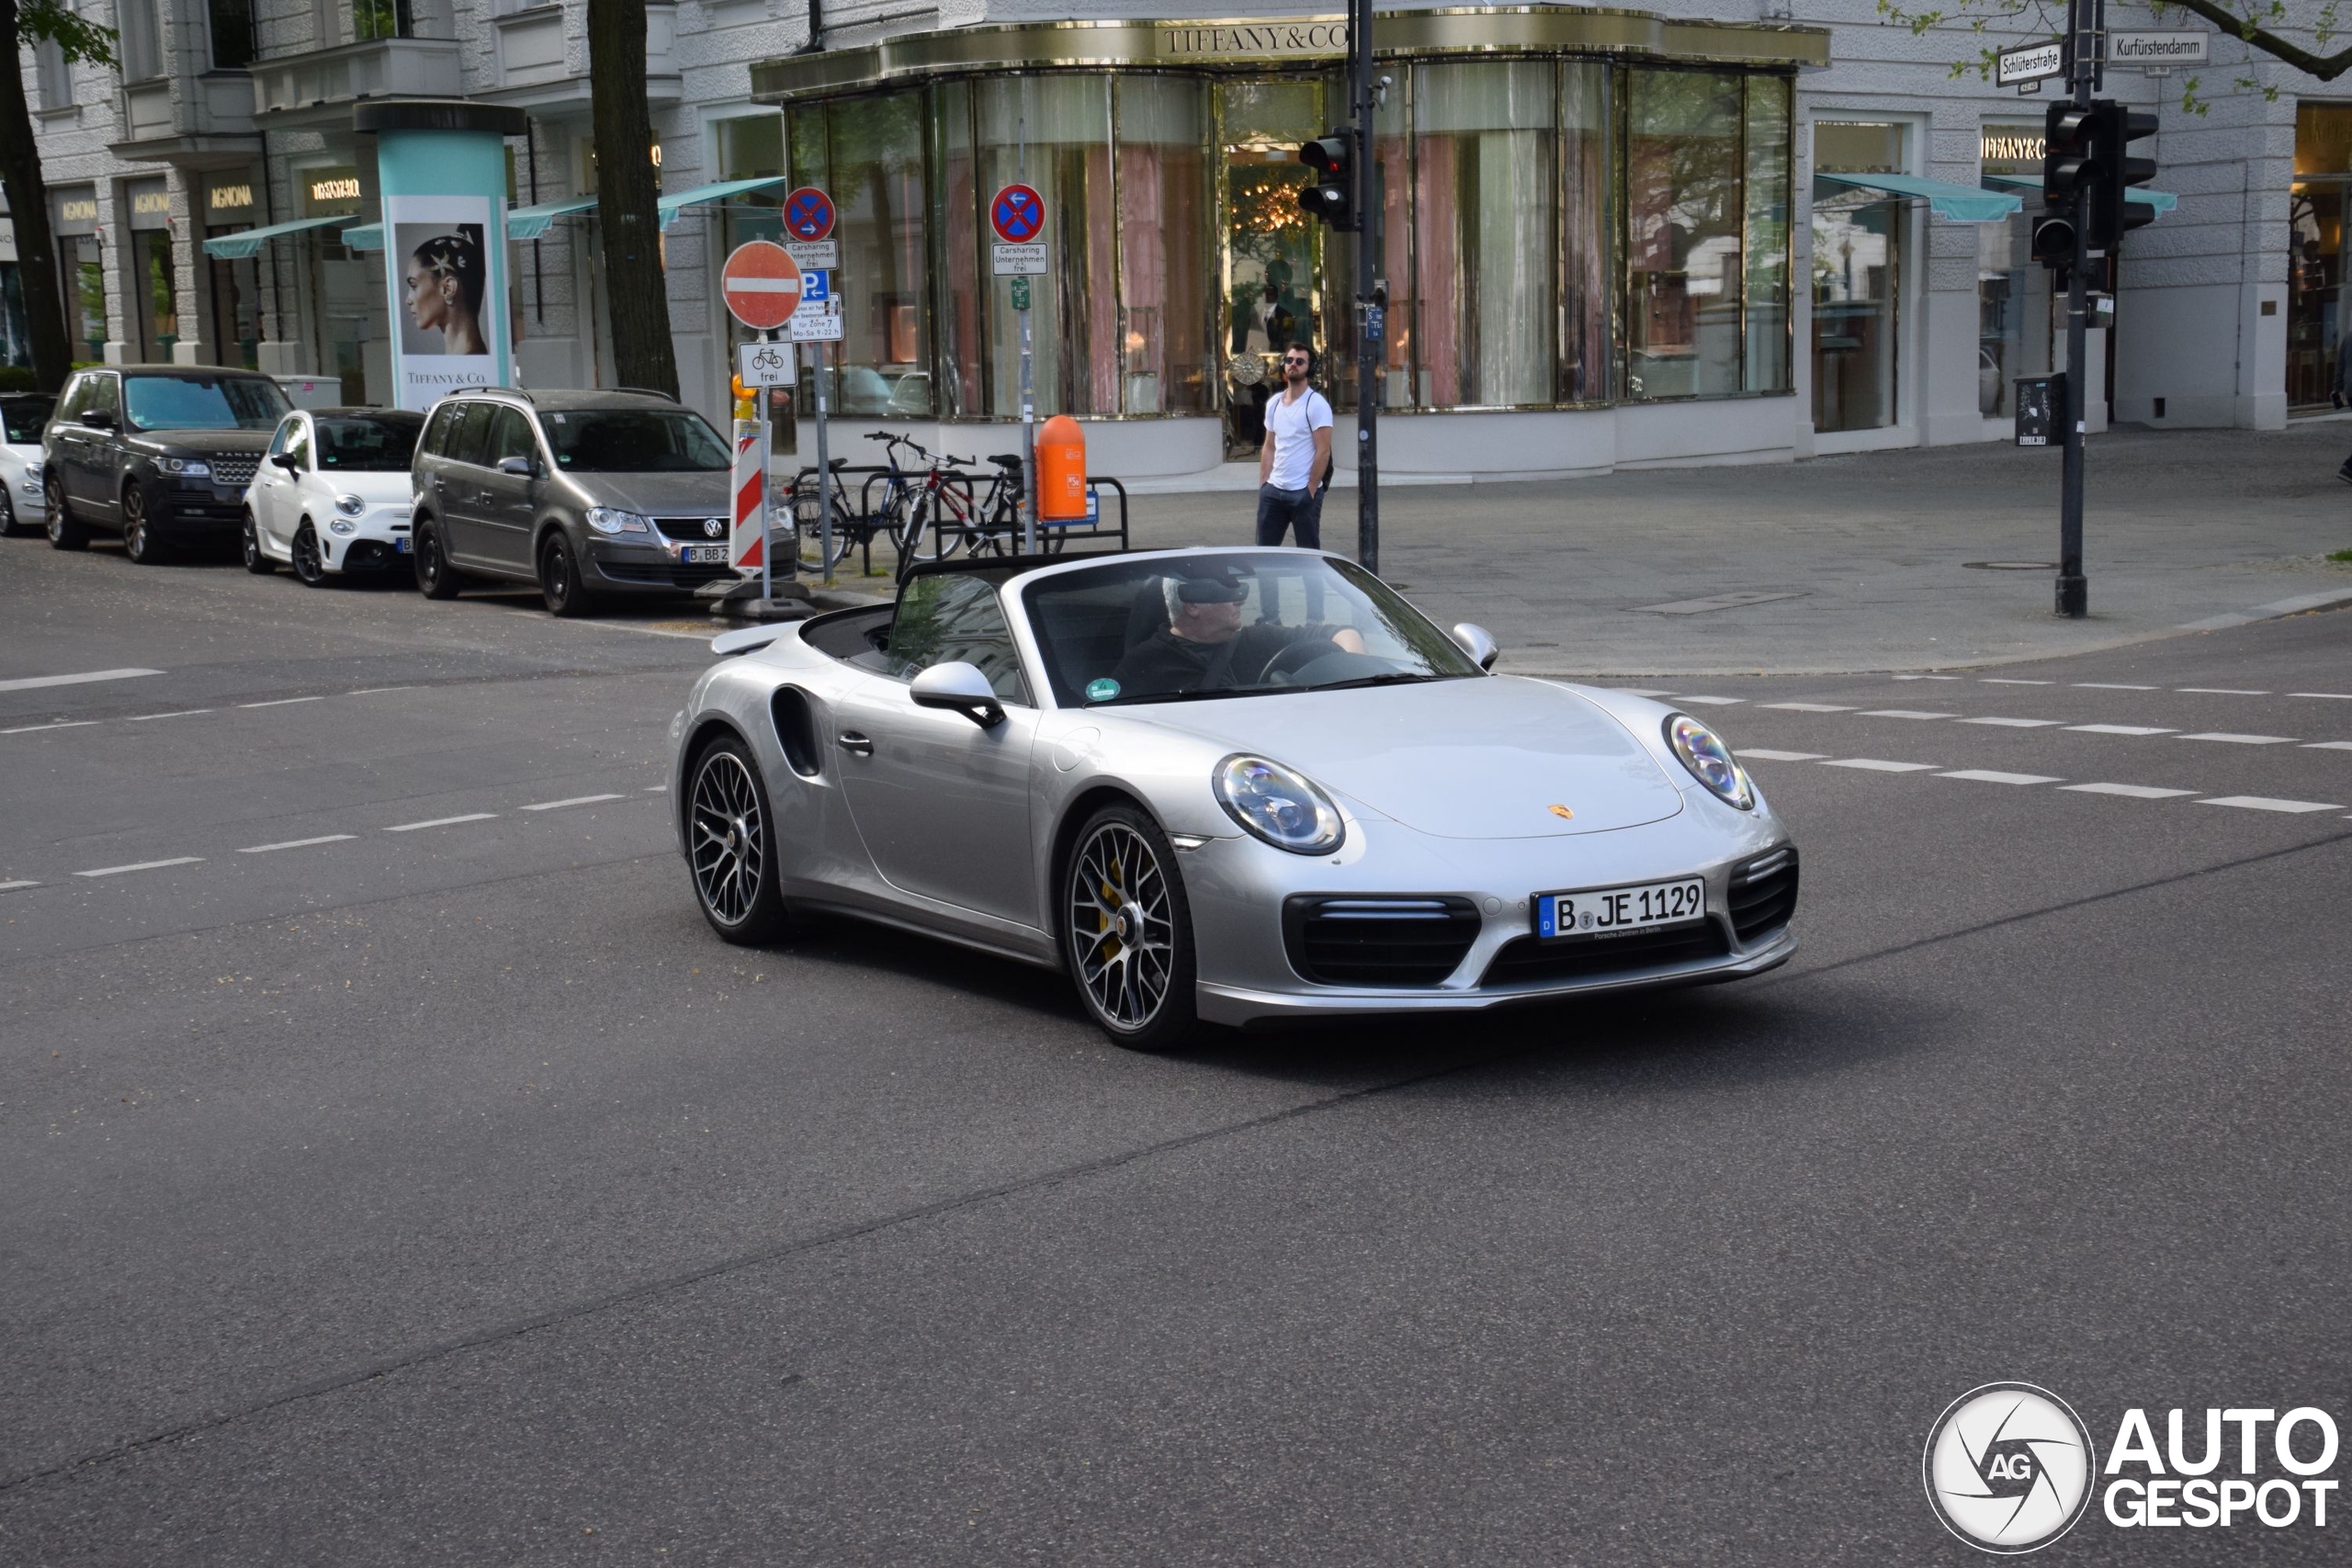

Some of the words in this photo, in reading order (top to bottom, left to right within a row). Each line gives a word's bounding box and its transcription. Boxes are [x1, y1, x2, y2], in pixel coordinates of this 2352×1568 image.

[2117, 38, 2199, 57] Kurfürstendamm
[2004, 50, 2057, 74] Schlüterstraße
[211, 185, 253, 209] AGNONA
[63, 200, 96, 220] AGNONA
[408, 372, 455, 384] TIFFANY
[761, 372, 777, 381] frei
[691, 550, 696, 560] B
[706, 549, 718, 559] BB
[1558, 900, 1576, 931] B
[1598, 894, 1633, 927] JE
[1639, 885, 1700, 921] 1129
[1544, 921, 1550, 931] D
